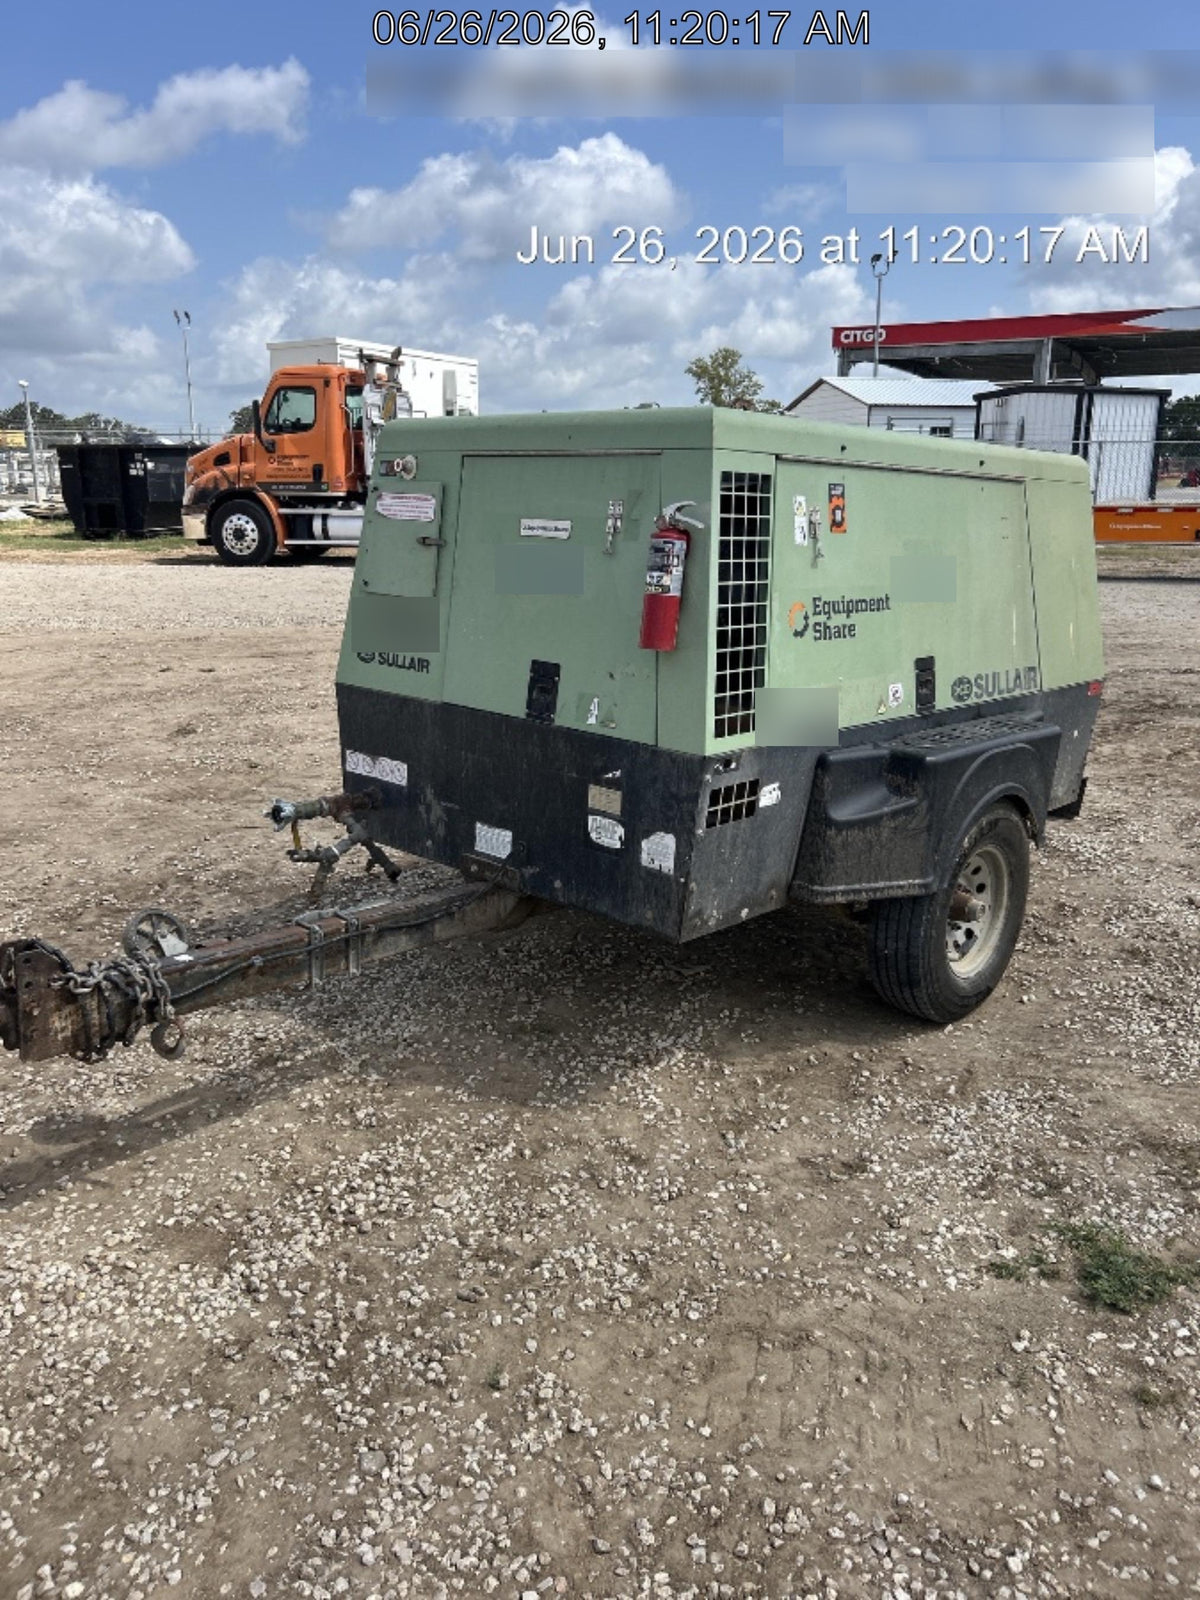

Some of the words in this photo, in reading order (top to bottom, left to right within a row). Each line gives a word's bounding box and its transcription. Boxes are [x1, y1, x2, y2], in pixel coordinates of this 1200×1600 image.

[840, 328, 887, 343] CITGO
[812, 593, 891, 620] Equipment
[813, 621, 856, 642] Share
[378, 652, 431, 674] SULLAIR
[974, 666, 1038, 699] SULLAIR
